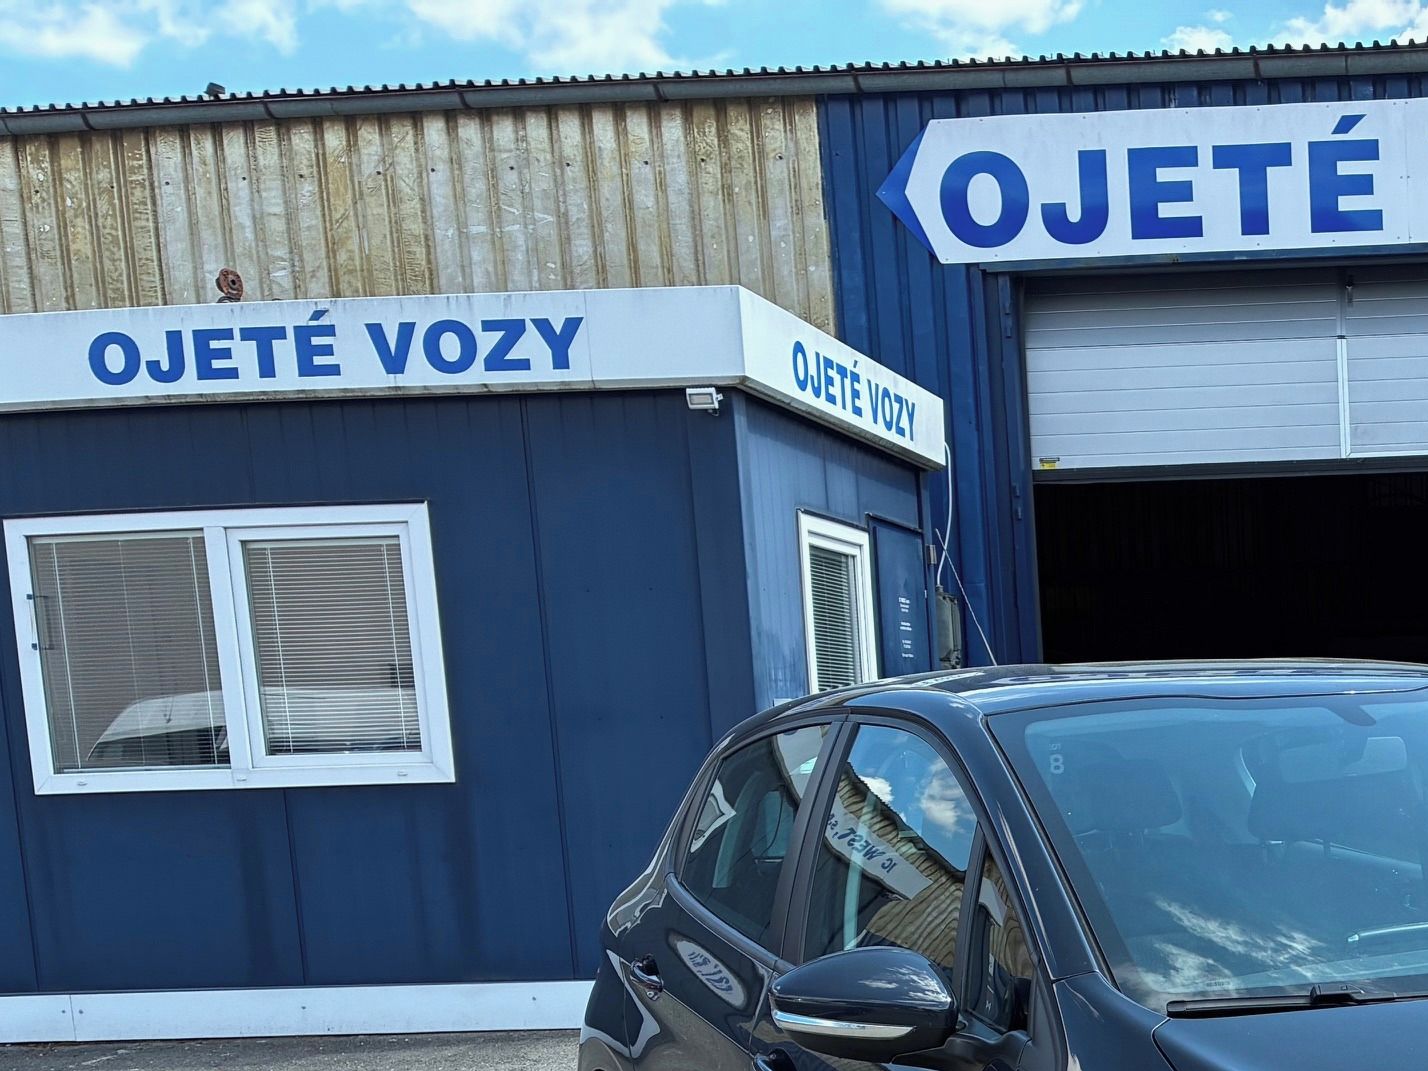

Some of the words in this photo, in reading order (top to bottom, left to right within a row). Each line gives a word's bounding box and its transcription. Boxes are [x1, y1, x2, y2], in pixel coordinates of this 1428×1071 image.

[939, 114, 1384, 248] OJETÉ
[88, 308, 341, 386] OJETÉ
[365, 316, 584, 375] VOZY
[792, 340, 863, 418] OJETÉ
[866, 378, 916, 442] VOZY
